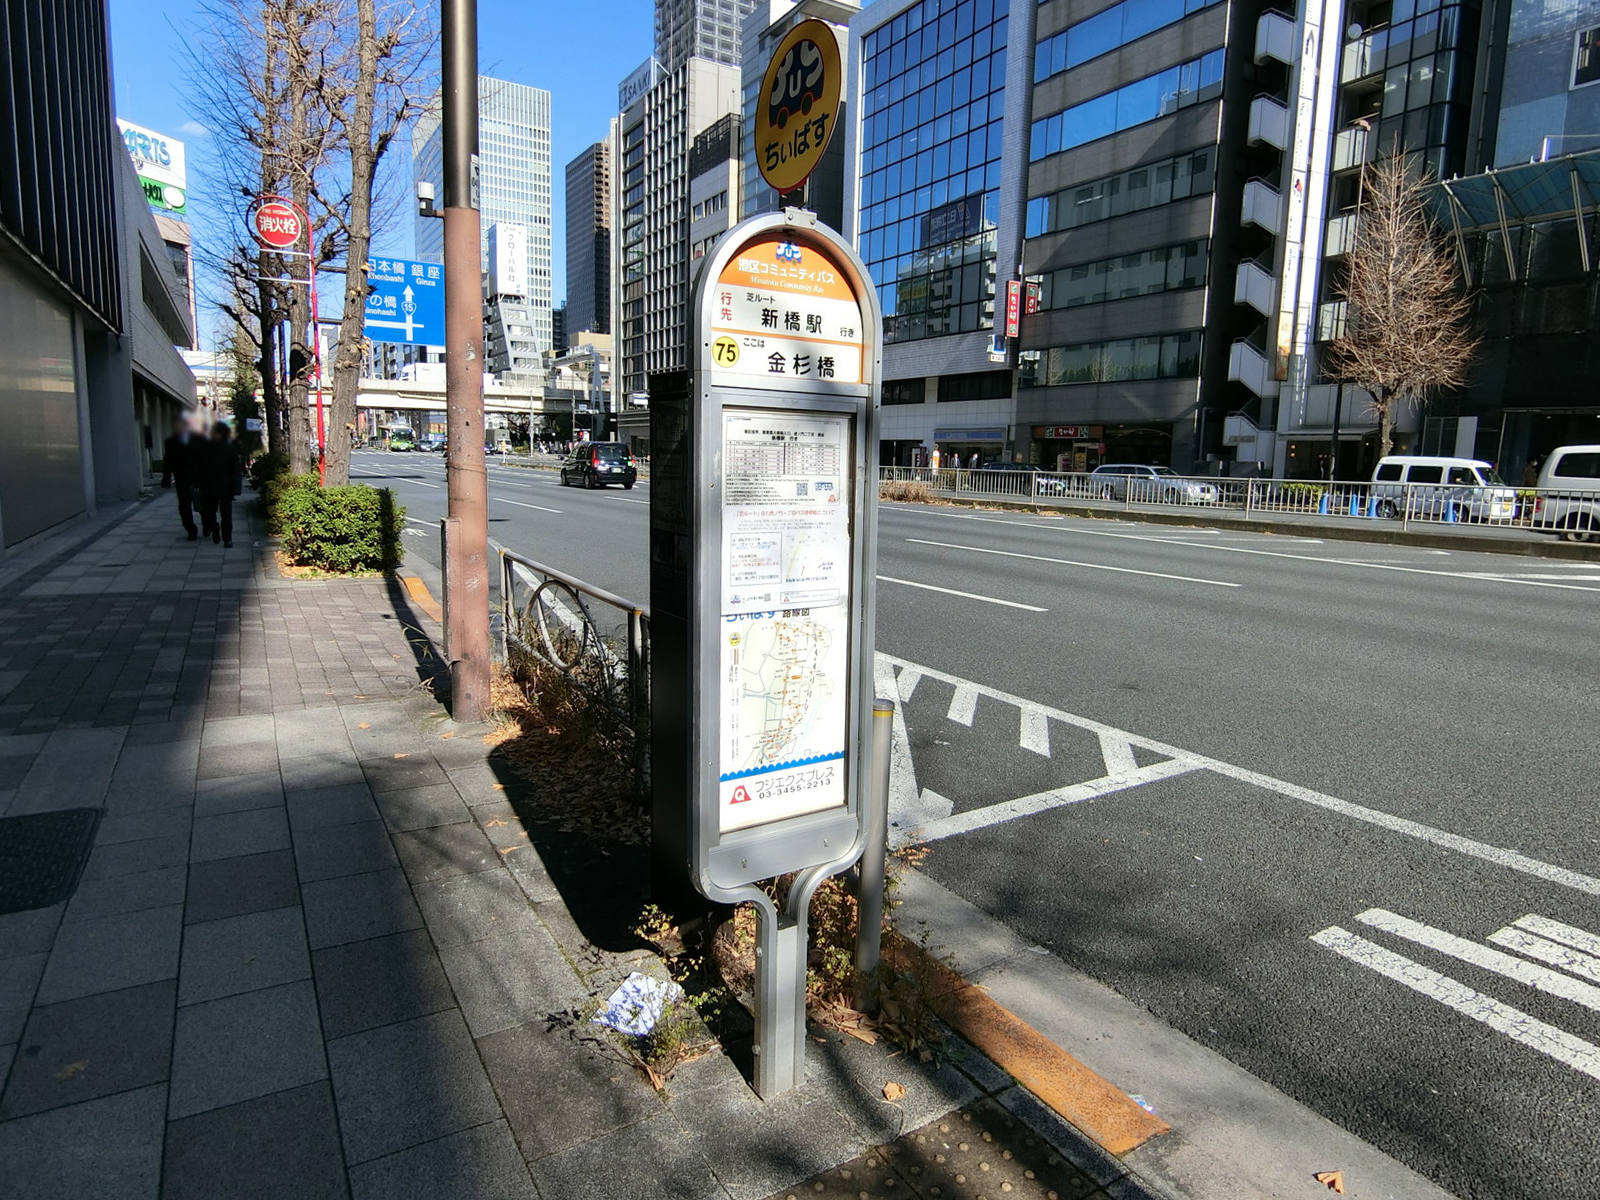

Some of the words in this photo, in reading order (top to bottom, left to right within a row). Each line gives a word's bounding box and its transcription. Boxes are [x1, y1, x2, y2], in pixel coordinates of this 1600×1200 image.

[259, 215, 297, 235] 消火栓
[411, 264, 440, 279] 銀座
[738, 257, 836, 285] 港区コミュニティバス
[416, 277, 436, 287] Ginza
[779, 280, 812, 293] Community
[813, 286, 824, 294] Bus
[365, 294, 397, 309] の橋
[720, 291, 732, 322] 行先
[746, 292, 776, 305] 芝ルート
[404, 303, 414, 312] 15
[761, 307, 823, 335] 新橋駅
[839, 327, 855, 338] 行き
[743, 337, 766, 349] ここは
[716, 343, 736, 363] 75
[768, 351, 835, 378] 金杉橋
[755, 766, 835, 793] フジエクスプレス
[759, 778, 832, 799] 03-3455-2213
